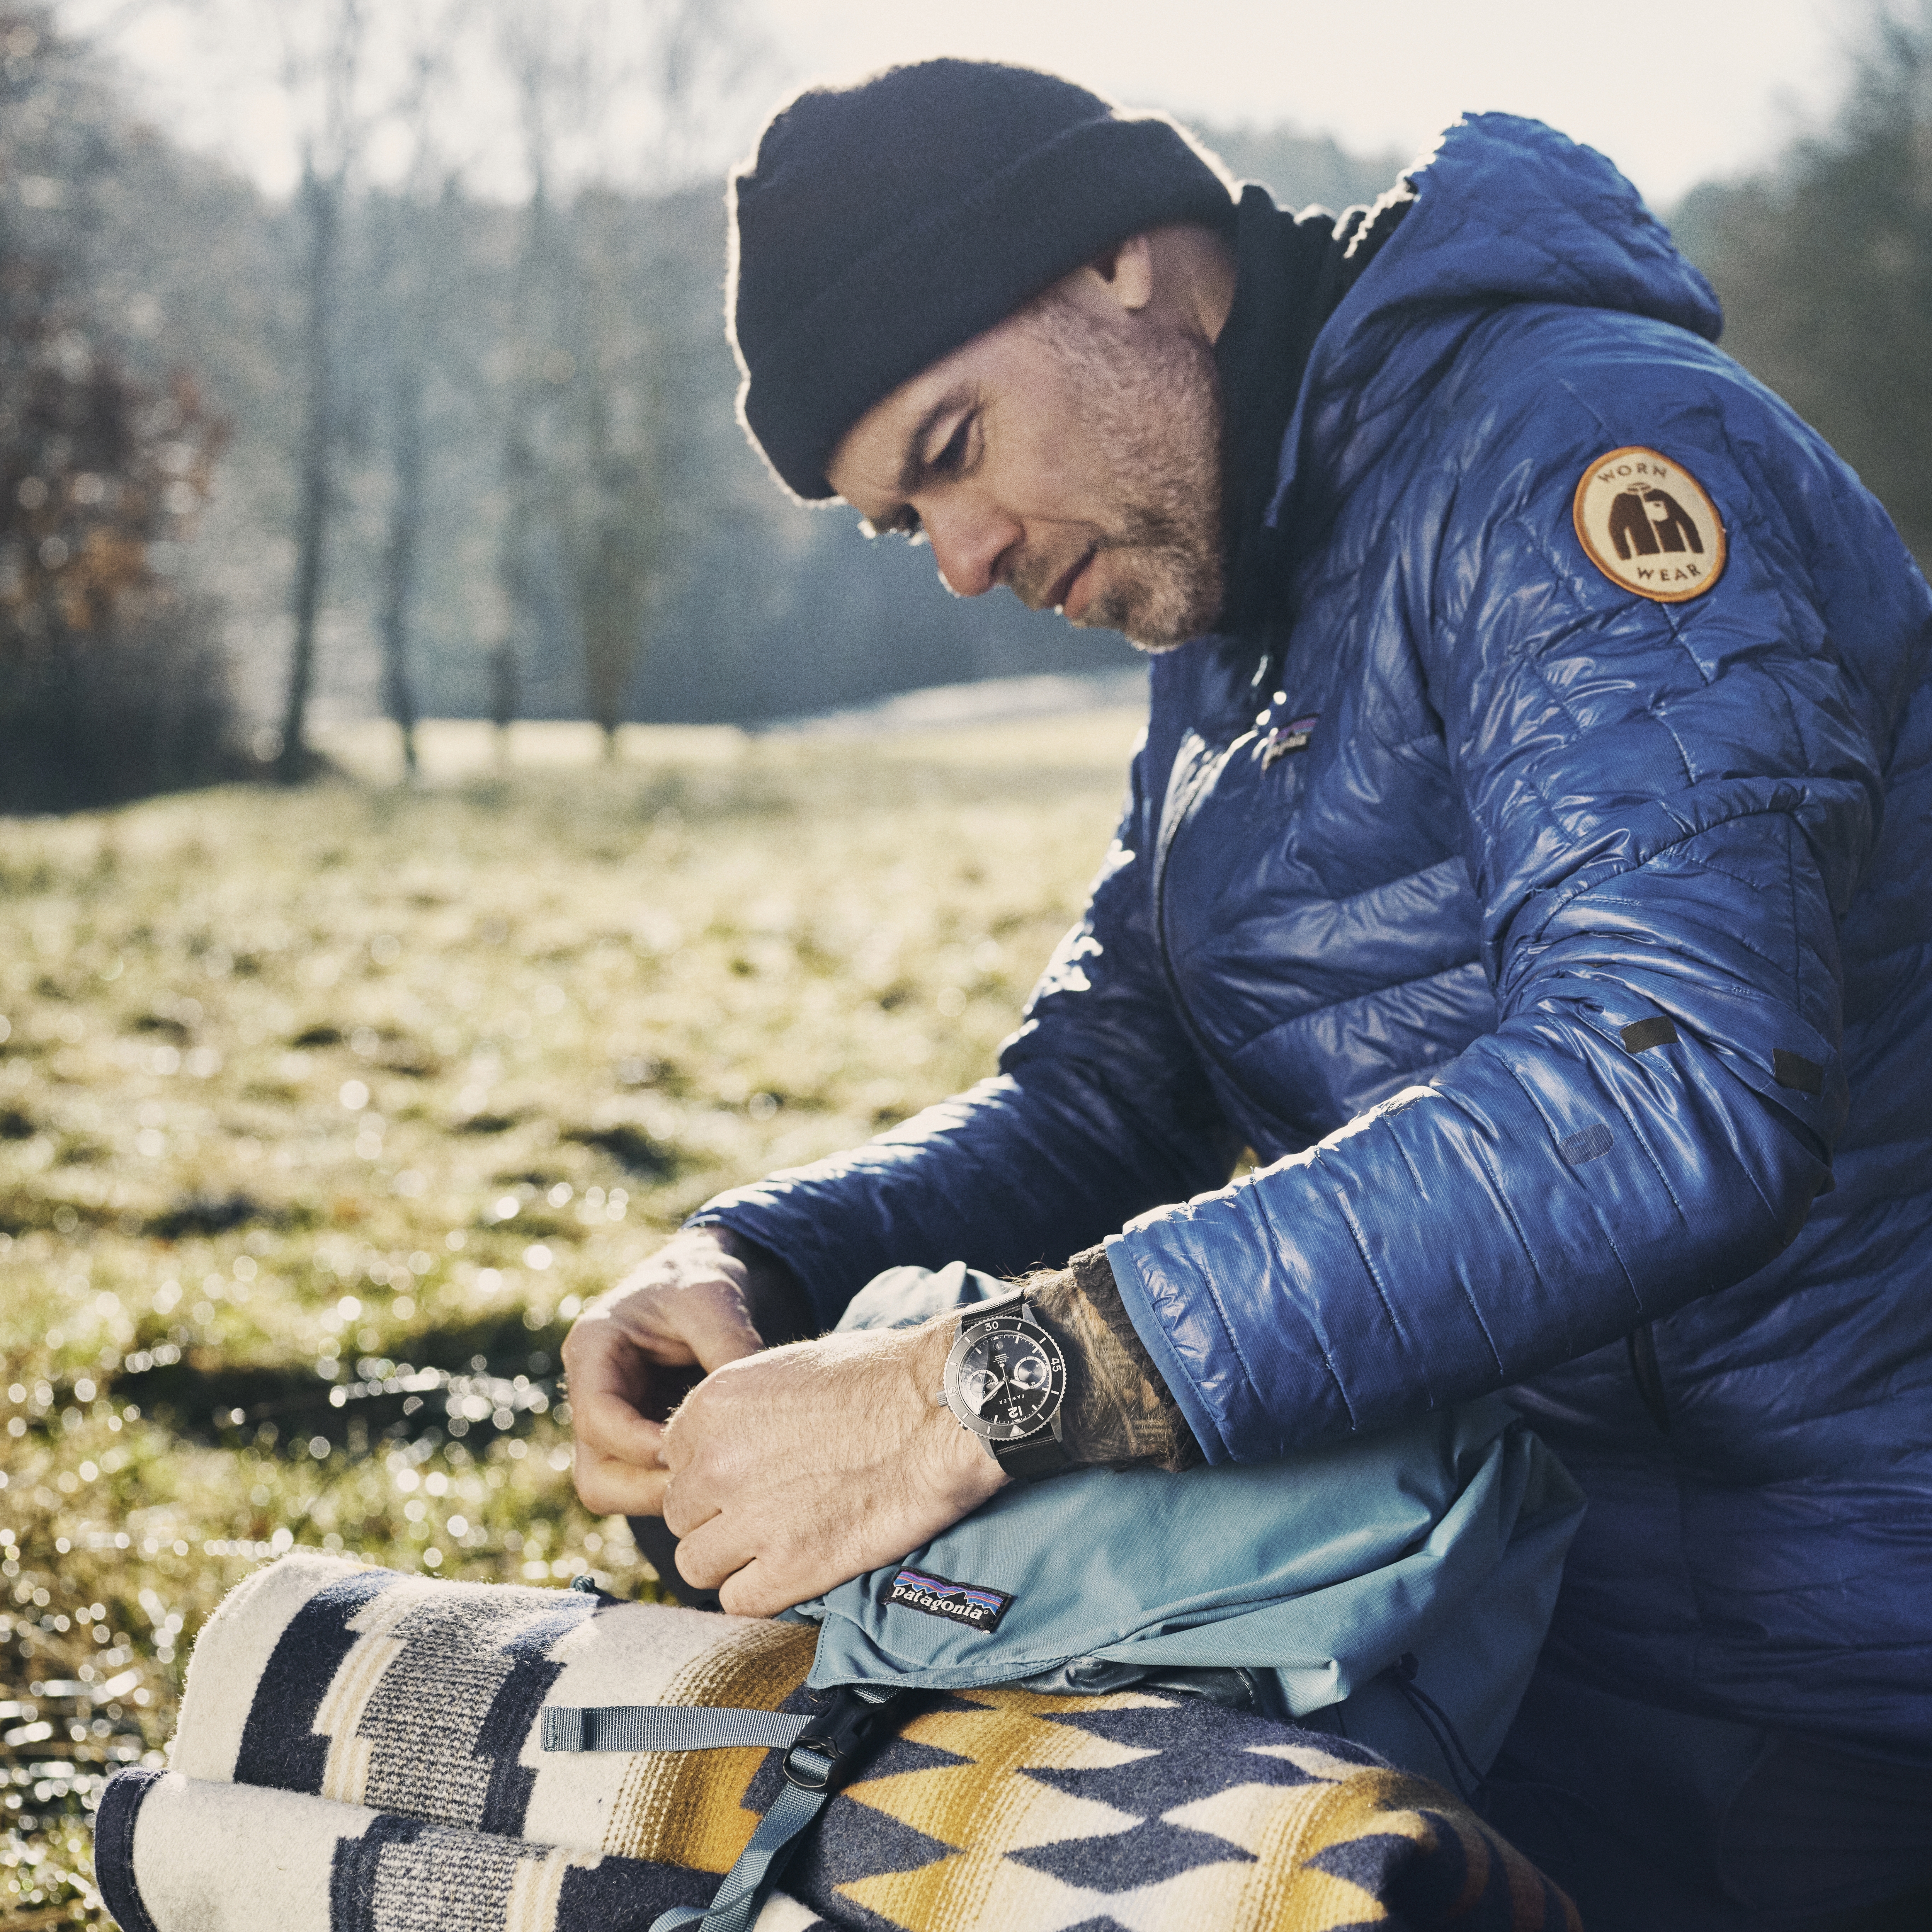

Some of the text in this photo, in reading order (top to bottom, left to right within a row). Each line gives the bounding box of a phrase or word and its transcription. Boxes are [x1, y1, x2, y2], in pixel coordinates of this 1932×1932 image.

[1597, 463, 1668, 483] WORN
[1637, 563, 1701, 582] WEAR
[985, 1321, 999, 1331] 30
[1051, 1358, 1062, 1372] 45
[947, 1386, 958, 1397] 15
[999, 1393, 1025, 1405] FAWLER
[1007, 1405, 1023, 1418] 12
